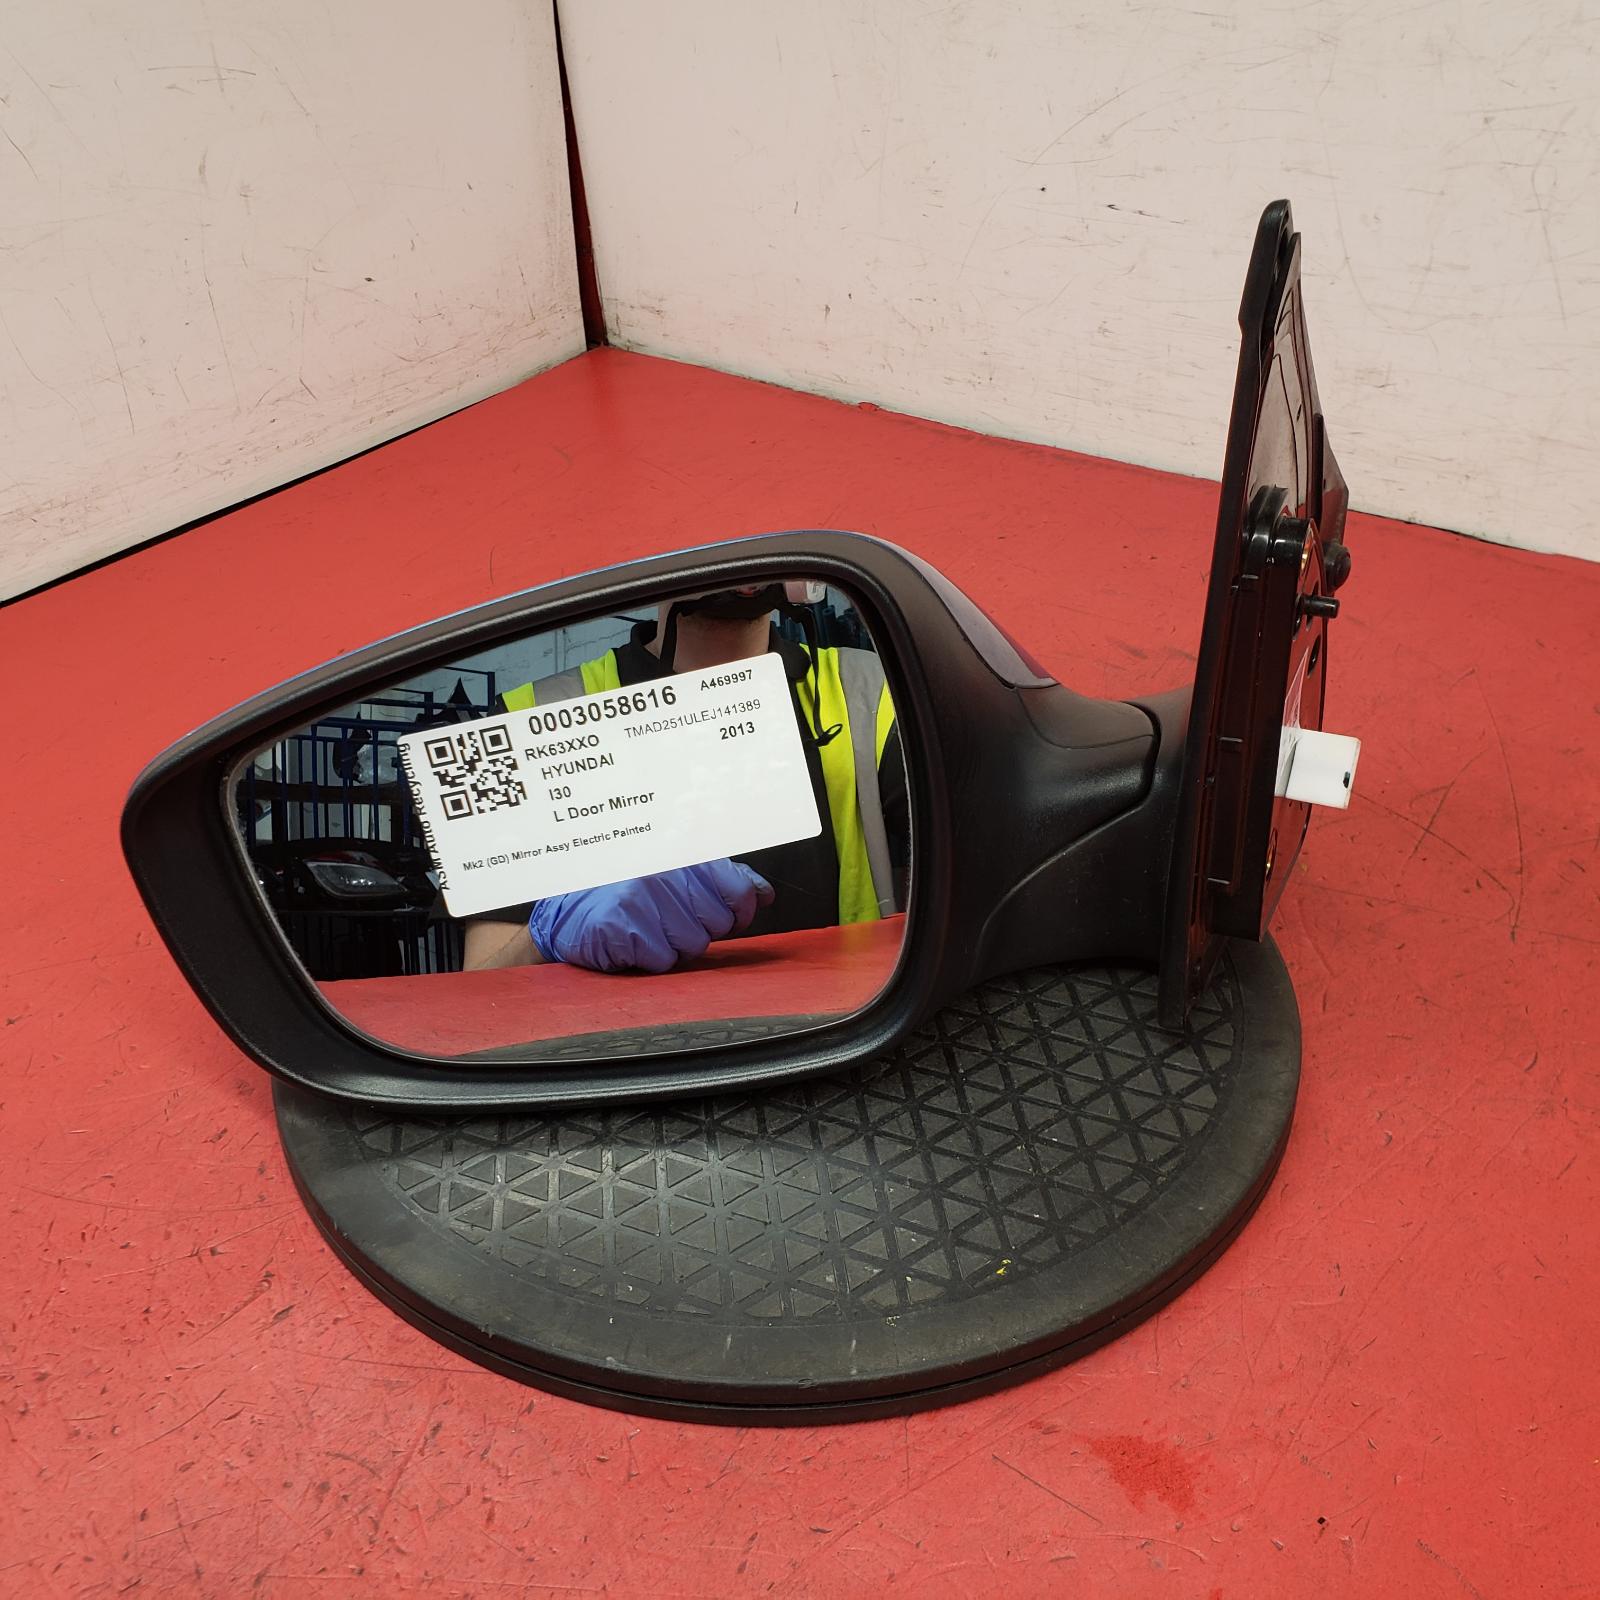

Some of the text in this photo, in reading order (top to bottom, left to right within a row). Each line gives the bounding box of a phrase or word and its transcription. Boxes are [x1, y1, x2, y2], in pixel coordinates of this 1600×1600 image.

[700, 669, 753, 691] A469997
[529, 685, 677, 735] 0003058616
[624, 699, 761, 738] TMAD251ULEJ141389
[719, 721, 755, 740] 2013
[525, 734, 600, 761] RK63XXO
[541, 752, 615, 780] HYUNDAI
[549, 785, 572, 801] I30
[553, 791, 655, 823] L Door Mirror
[463, 823, 652, 872] Mk2 (GD) Mirror Assy Electric Painted
